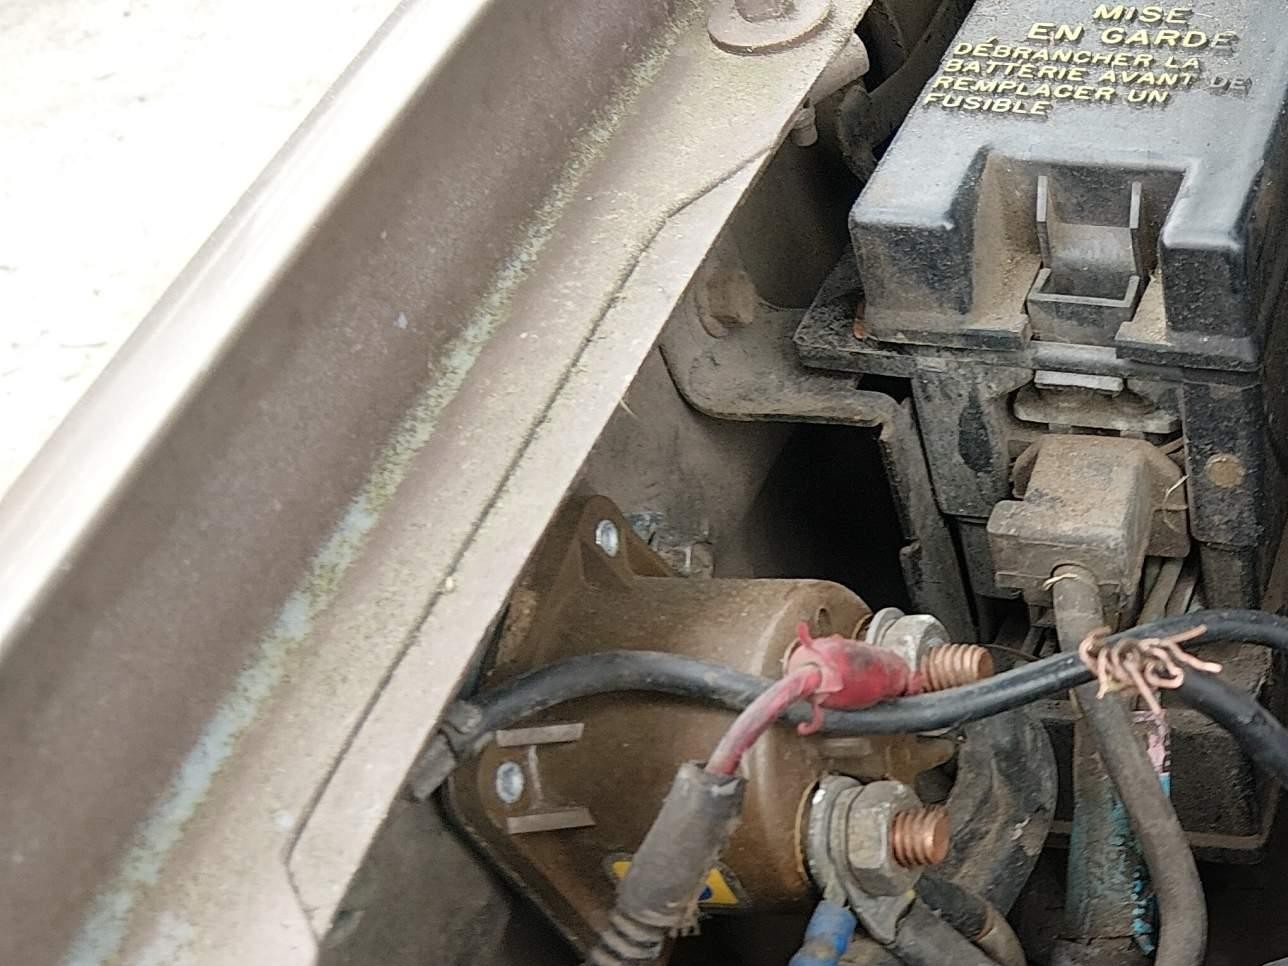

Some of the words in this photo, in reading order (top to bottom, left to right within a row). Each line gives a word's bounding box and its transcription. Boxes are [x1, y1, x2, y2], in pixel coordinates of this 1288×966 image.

[1092, 4, 1192, 25] MISE
[1027, 23, 1085, 43] EN
[1100, 27, 1240, 51] GARDE
[953, 36, 1154, 68] DÉBRANCHER
[1167, 56, 1202, 71] LA
[931, 76, 1119, 104] REMPLACER
[1127, 88, 1172, 105] UN
[1097, 70, 1195, 87] AVANT
[923, 93, 1053, 117] FUSIBLE
